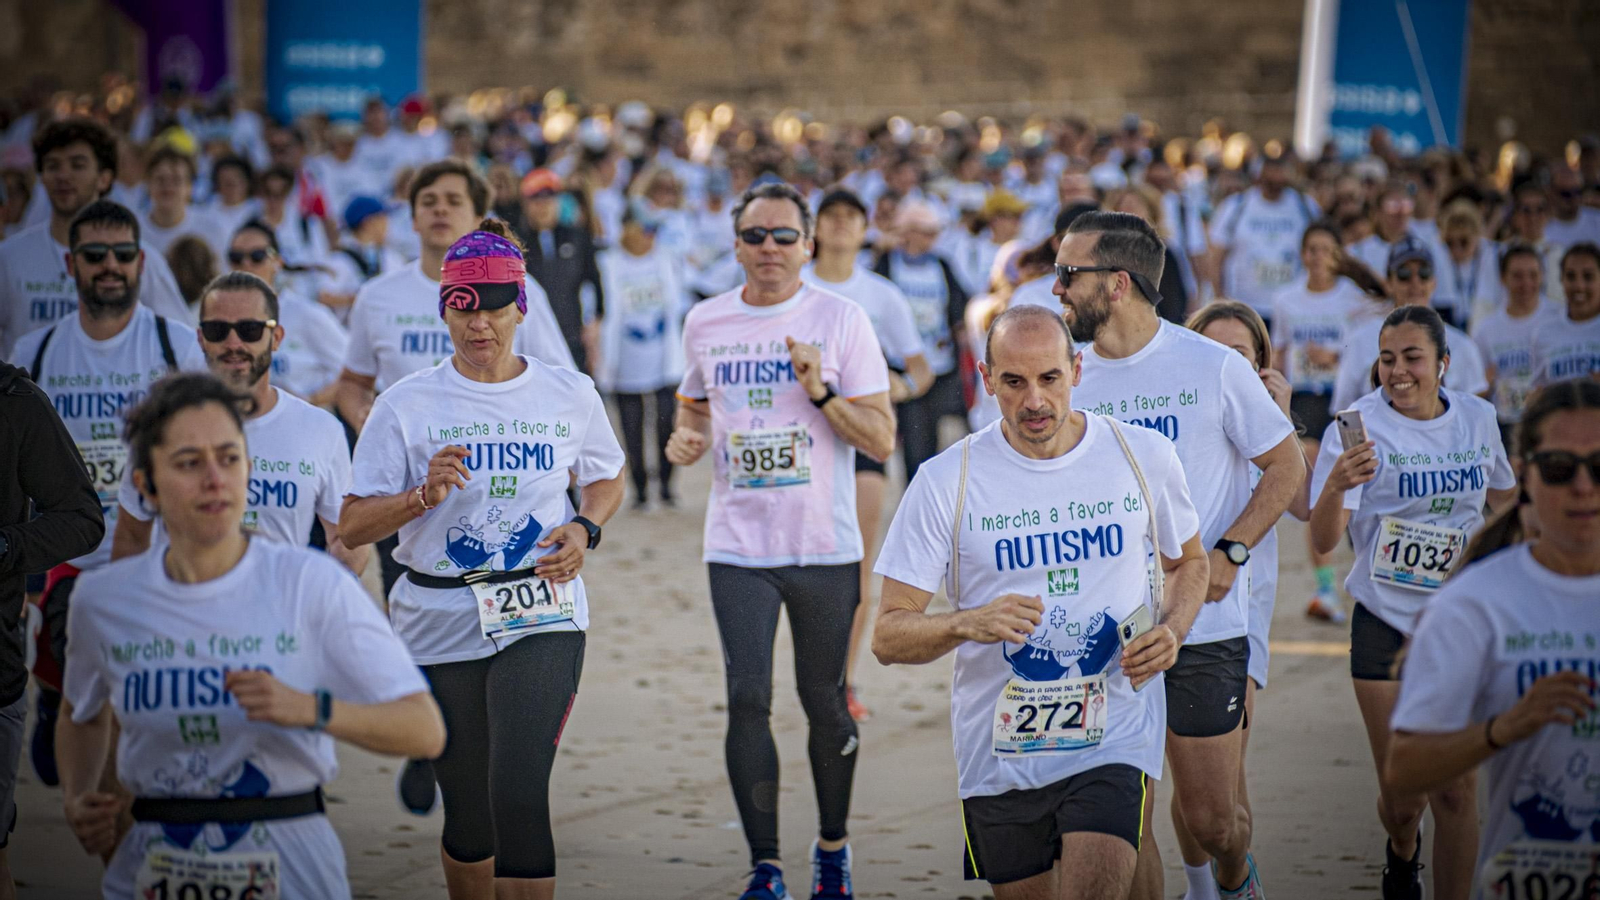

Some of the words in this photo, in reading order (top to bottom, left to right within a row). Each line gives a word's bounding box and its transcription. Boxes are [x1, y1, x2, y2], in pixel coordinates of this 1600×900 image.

[402, 330, 455, 354] AUTIS
[711, 341, 749, 356] marcha
[755, 342, 762, 354] a
[109, 371, 141, 385] favor
[715, 359, 799, 386] AUTISM
[1120, 400, 1127, 413] a
[1134, 395, 1171, 411] favor
[1179, 388, 1198, 406] del
[428, 426, 432, 441] I
[440, 422, 489, 440] marcha
[497, 423, 505, 435] a
[513, 419, 549, 436] favor
[555, 420, 570, 438] del
[253, 455, 291, 473] favor
[299, 458, 315, 476] del
[742, 447, 793, 472] 985
[1388, 452, 1431, 466] marcha
[1398, 465, 1484, 498] AUTISMO
[969, 512, 973, 531] I
[981, 508, 1040, 531] marcha
[1050, 507, 1059, 523] a
[1068, 501, 1114, 520] favor
[1123, 492, 1143, 512] del
[994, 523, 1124, 572] AUTISMO
[1388, 538, 1453, 572] 1032
[495, 579, 552, 614] 201
[111, 635, 175, 662] marcha
[185, 638, 196, 657] a
[209, 633, 262, 656] favor
[275, 630, 297, 654] de
[123, 664, 273, 713] AUTIS
[1016, 701, 1084, 733] 272
[1010, 734, 1046, 742] MARIANO
